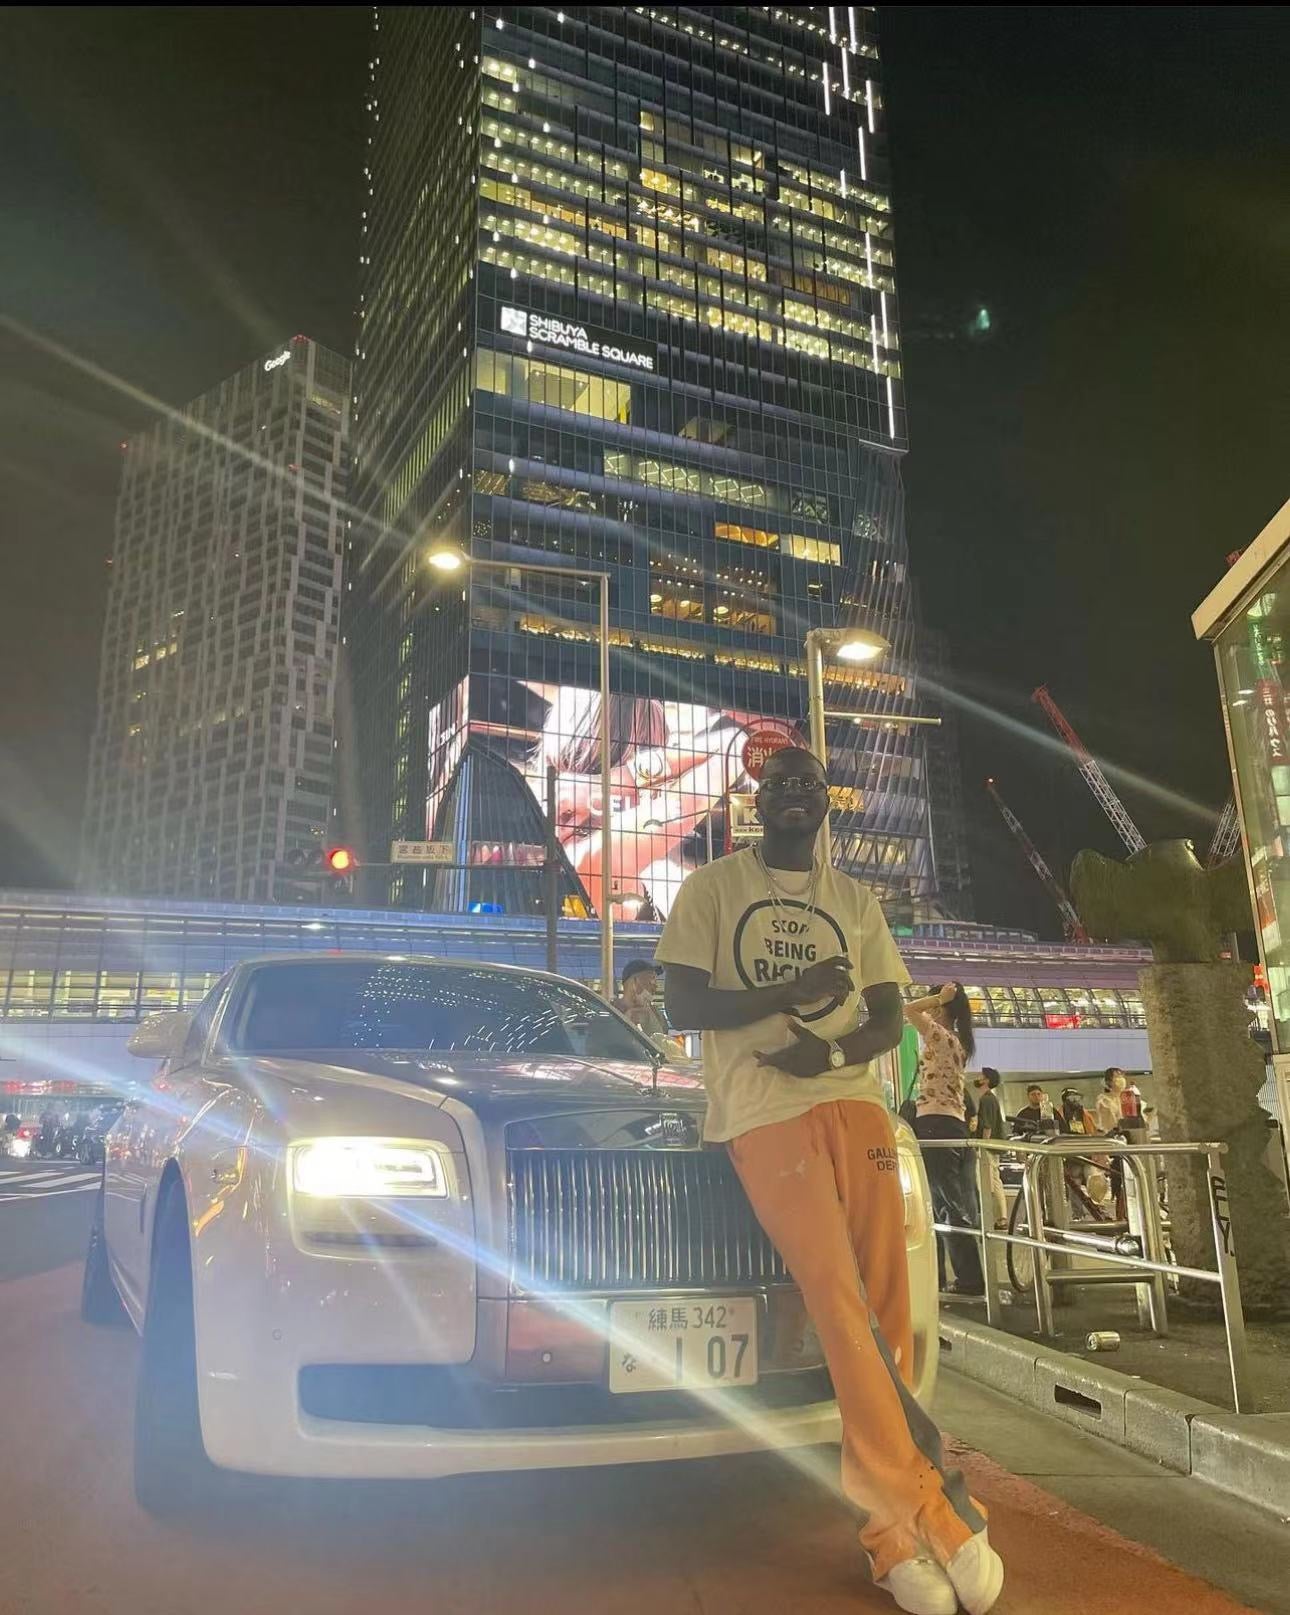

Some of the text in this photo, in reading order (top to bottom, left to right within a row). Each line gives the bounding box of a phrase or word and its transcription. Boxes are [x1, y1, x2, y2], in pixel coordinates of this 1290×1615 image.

[529, 313, 588, 339] SHIBUYA
[264, 350, 291, 371] Google
[529, 327, 654, 369] SCRAMBLE SQUARE
[771, 919, 810, 935] STOP
[764, 937, 817, 963] BEING
[753, 958, 804, 983] RACI
[648, 1306, 728, 1331] 練馬 342
[622, 1352, 637, 1374] な
